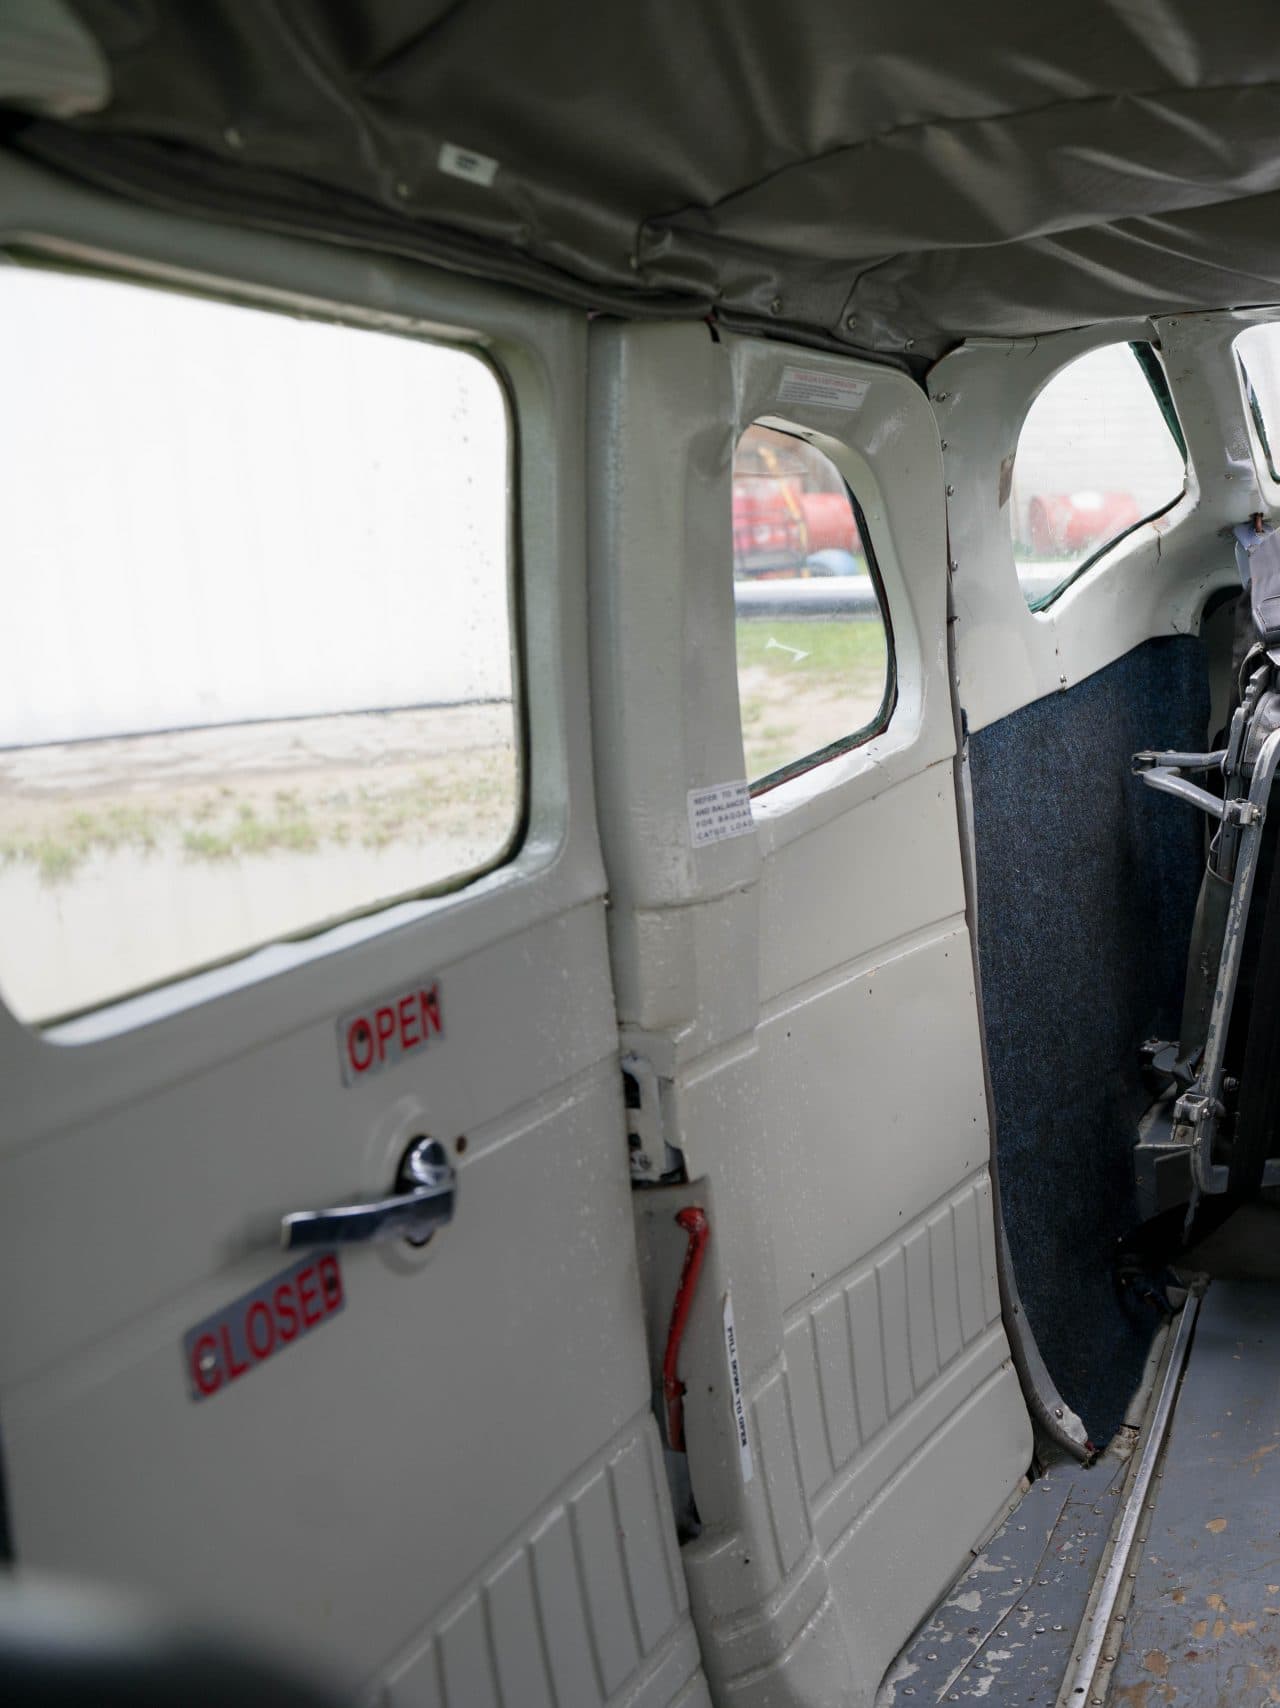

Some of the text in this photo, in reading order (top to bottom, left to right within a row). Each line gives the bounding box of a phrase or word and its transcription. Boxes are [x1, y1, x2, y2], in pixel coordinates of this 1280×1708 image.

[694, 794, 717, 805] REFER
[722, 790, 732, 798] TO
[695, 807, 710, 816] AND
[712, 799, 745, 812] BALANCE
[696, 817, 713, 828] FOR
[346, 981, 443, 1072] OPEN
[191, 1253, 345, 1397] CLOSED
[727, 1326, 736, 1357] PULL
[738, 1416, 748, 1448] OPEN
